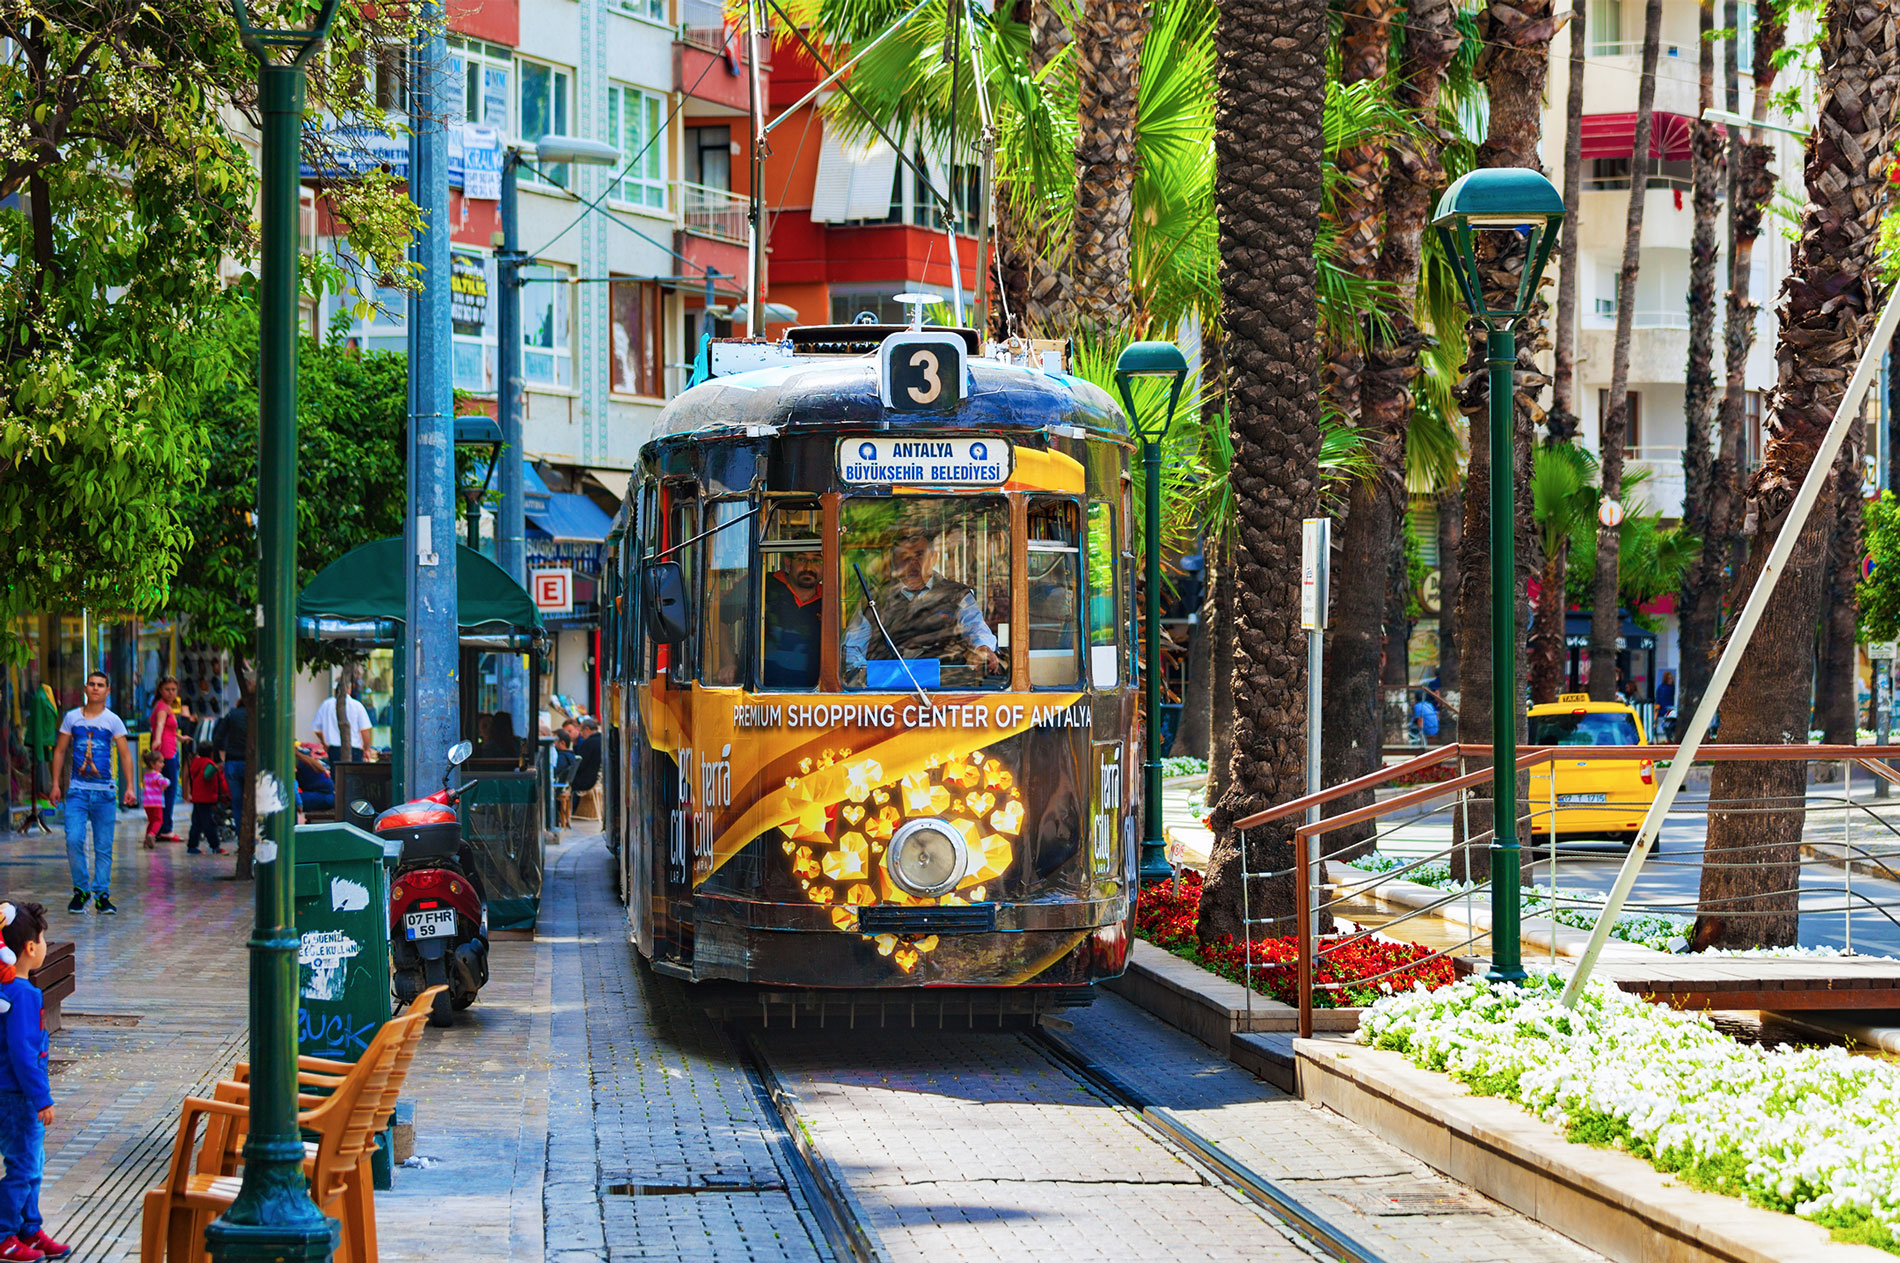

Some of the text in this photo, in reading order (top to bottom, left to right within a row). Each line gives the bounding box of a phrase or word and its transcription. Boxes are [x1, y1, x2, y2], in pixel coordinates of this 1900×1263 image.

[907, 350, 942, 404] 3
[892, 443, 953, 458] ANTALYA
[846, 462, 1001, 482] BÜYÜKŞEHİR BELEDİYESİ
[543, 581, 558, 600] E
[733, 704, 1092, 728] PREMIUM SHOPPING CENTER OF ANTALYA
[408, 911, 452, 926] 07 FHR
[420, 925, 436, 936] 59
